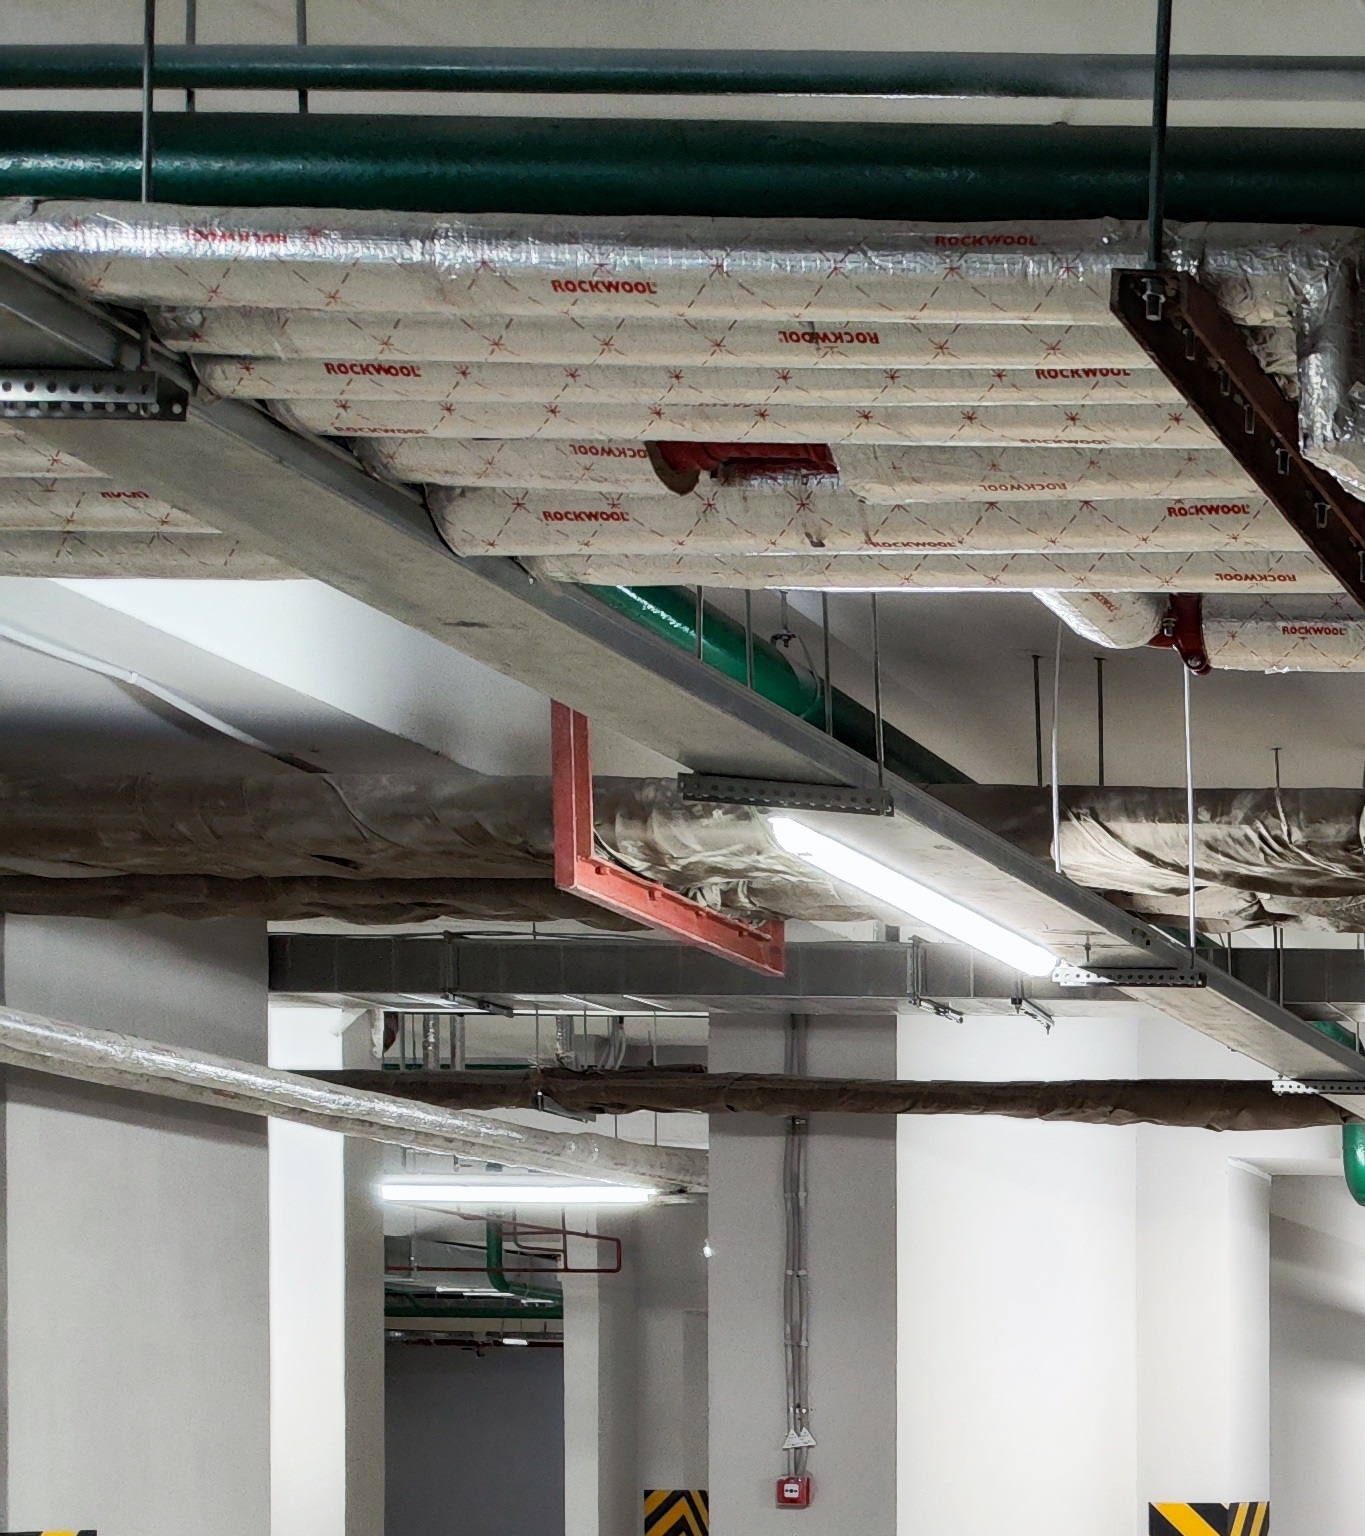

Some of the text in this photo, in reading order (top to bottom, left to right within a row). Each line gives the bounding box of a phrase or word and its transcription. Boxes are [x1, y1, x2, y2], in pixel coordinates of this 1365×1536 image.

[934, 234, 1038, 247] ROCKWOOL
[551, 279, 657, 294] ROCKWOOL
[778, 331, 880, 345] ROCKWOOL
[325, 362, 422, 378] ROCKWOOL
[1035, 368, 1131, 380] ROCKWOOL
[333, 426, 428, 435] ROCKWOOL
[1018, 438, 1110, 446] ROCKWOOL
[569, 444, 647, 459] OCKWOOL
[979, 483, 1067, 492] ROCKWOOL
[542, 510, 629, 522] ROCKWOOL
[1167, 504, 1250, 518] ROCKWOOL
[1215, 573, 1297, 582] ROCKWOOL
[1282, 626, 1347, 636] ROCKWOOL
